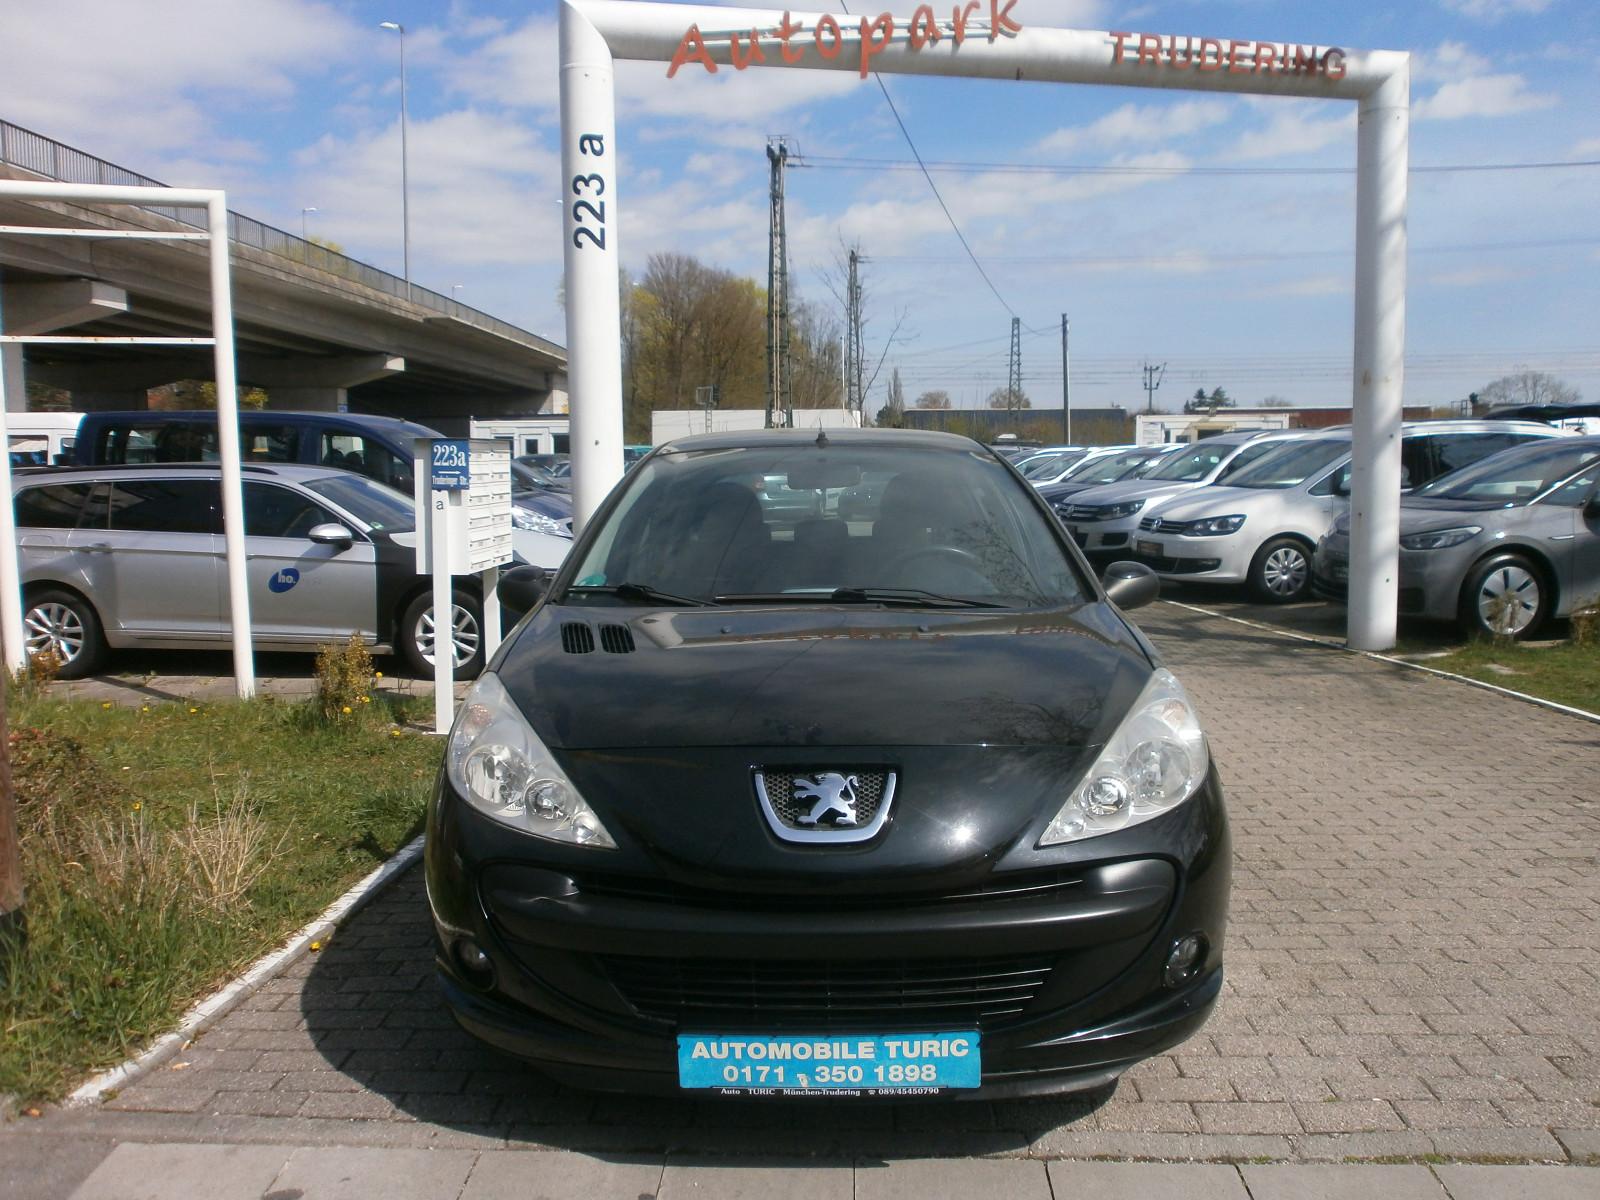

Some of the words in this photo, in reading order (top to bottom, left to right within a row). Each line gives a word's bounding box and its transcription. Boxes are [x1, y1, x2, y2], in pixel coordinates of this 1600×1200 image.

[667, 0, 1022, 79] Autopark
[1109, 31, 1347, 80] TRUDERING
[579, 133, 604, 156] a
[572, 173, 605, 250] 223
[433, 445, 466, 467] 223a
[436, 500, 444, 510] a
[691, 1041, 875, 1060] AUTOMOBILE
[885, 1039, 969, 1058] TURIC
[723, 1065, 785, 1083] 0171
[815, 1065, 863, 1082] 350
[873, 1064, 937, 1082] 1898
[748, 1088, 776, 1096] TURIC
[783, 1088, 861, 1097] München-Trudering
[878, 1086, 940, 1096] 089/45450790
